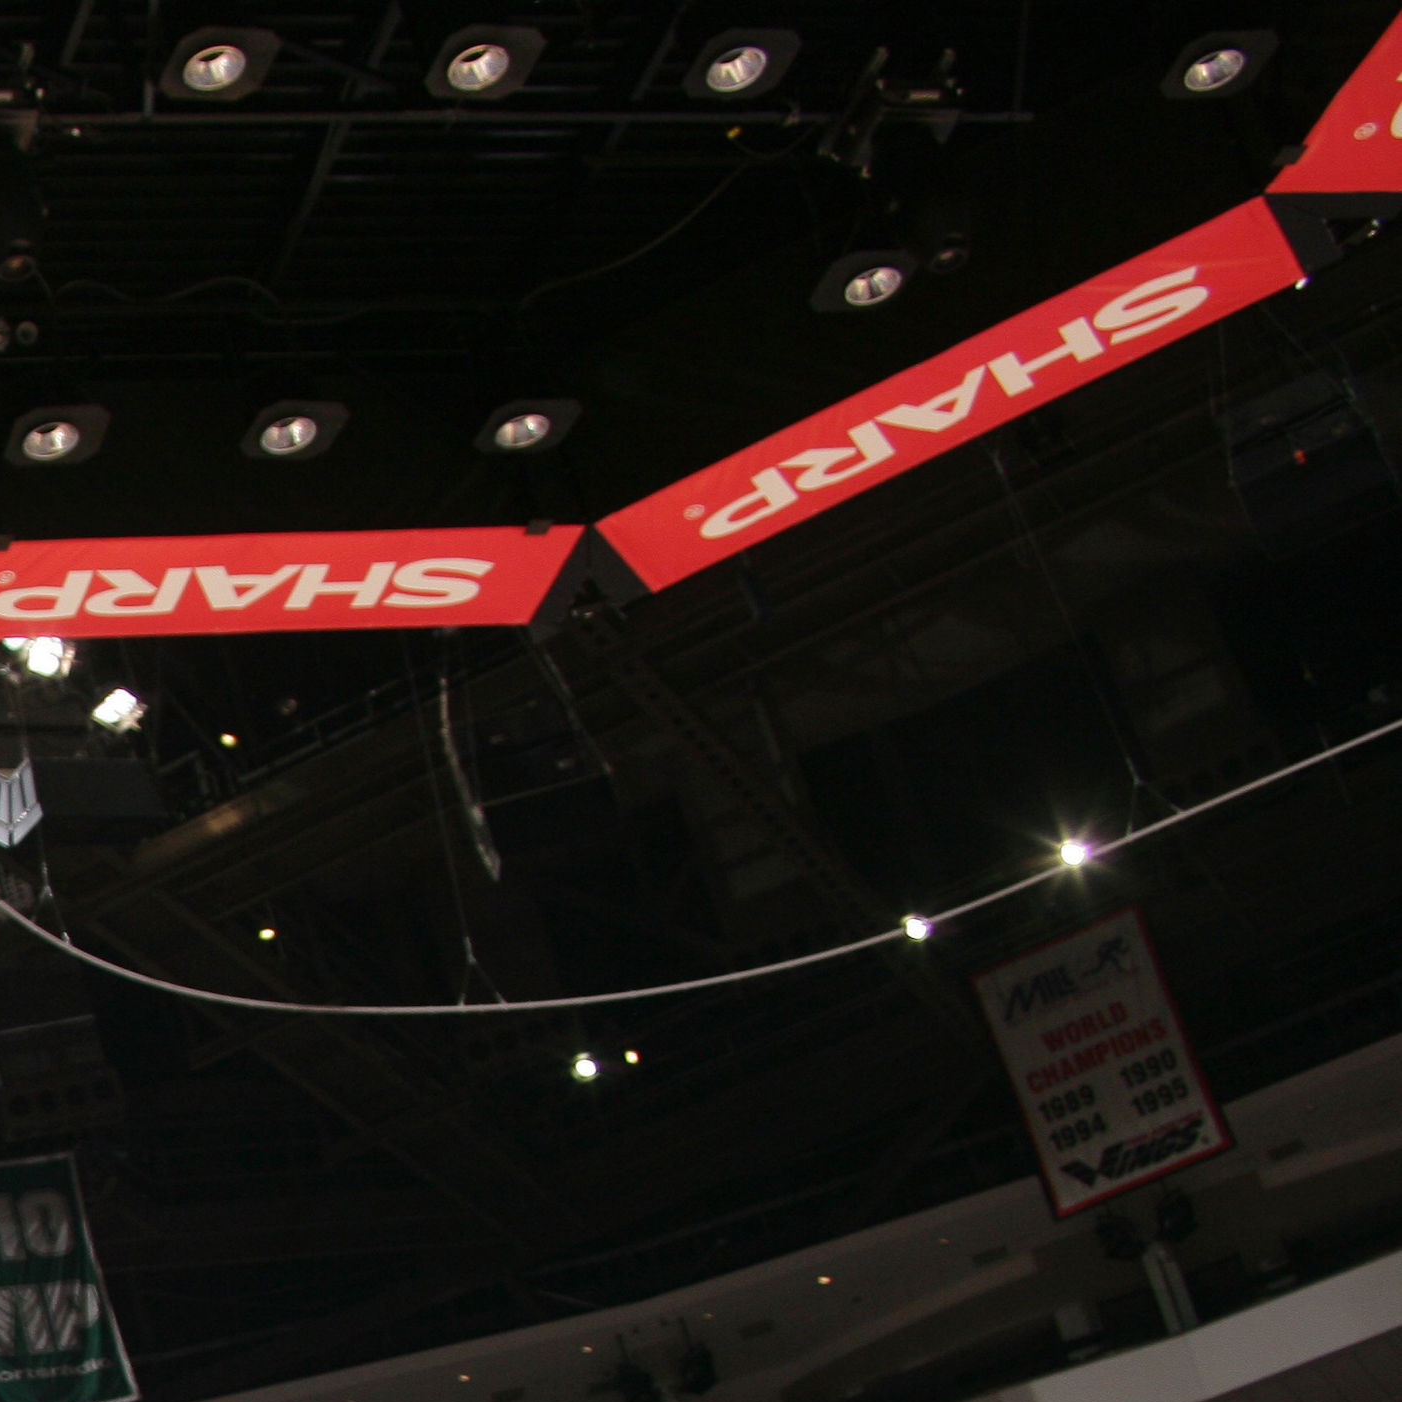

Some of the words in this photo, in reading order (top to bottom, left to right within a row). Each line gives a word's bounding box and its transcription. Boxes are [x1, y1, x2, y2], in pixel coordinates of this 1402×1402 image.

[698, 266, 1209, 540] SHARP
[1041, 1001, 1128, 1052] WORLD
[1025, 1018, 1167, 1093] CHAMPIONS
[1120, 1047, 1177, 1087] 1990
[1050, 1112, 1107, 1150] 1994
